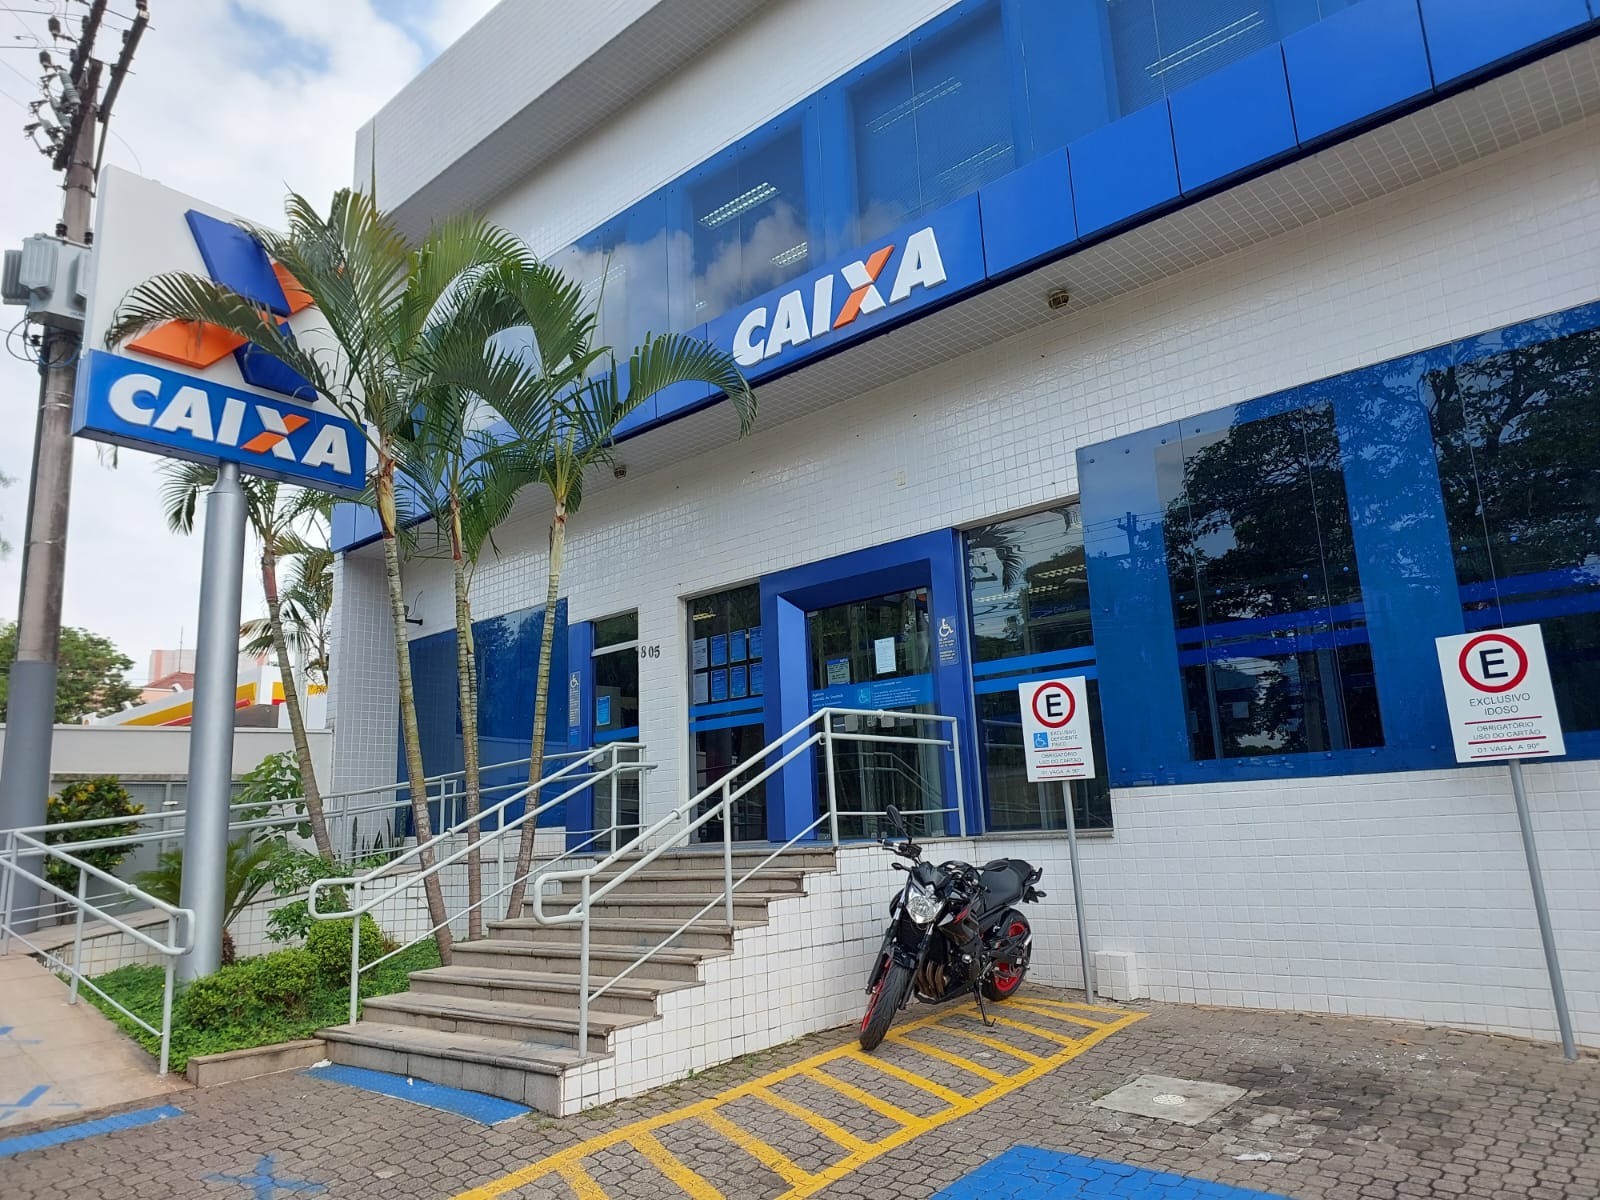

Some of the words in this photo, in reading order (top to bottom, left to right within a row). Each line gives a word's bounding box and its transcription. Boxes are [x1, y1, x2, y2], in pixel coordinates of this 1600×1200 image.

[732, 226, 947, 367] CAIXA
[108, 373, 352, 475] CAIXA
[641, 645, 660, 658] 805
[1479, 648, 1509, 679] E
[1045, 693, 1063, 717] E
[1469, 692, 1530, 707] EXCLUSIVO
[1484, 705, 1519, 716] IDOSO
[1473, 733, 1490, 741] USO
[1506, 729, 1541, 738] CARTÃO
[1490, 745, 1514, 753] VAGA
